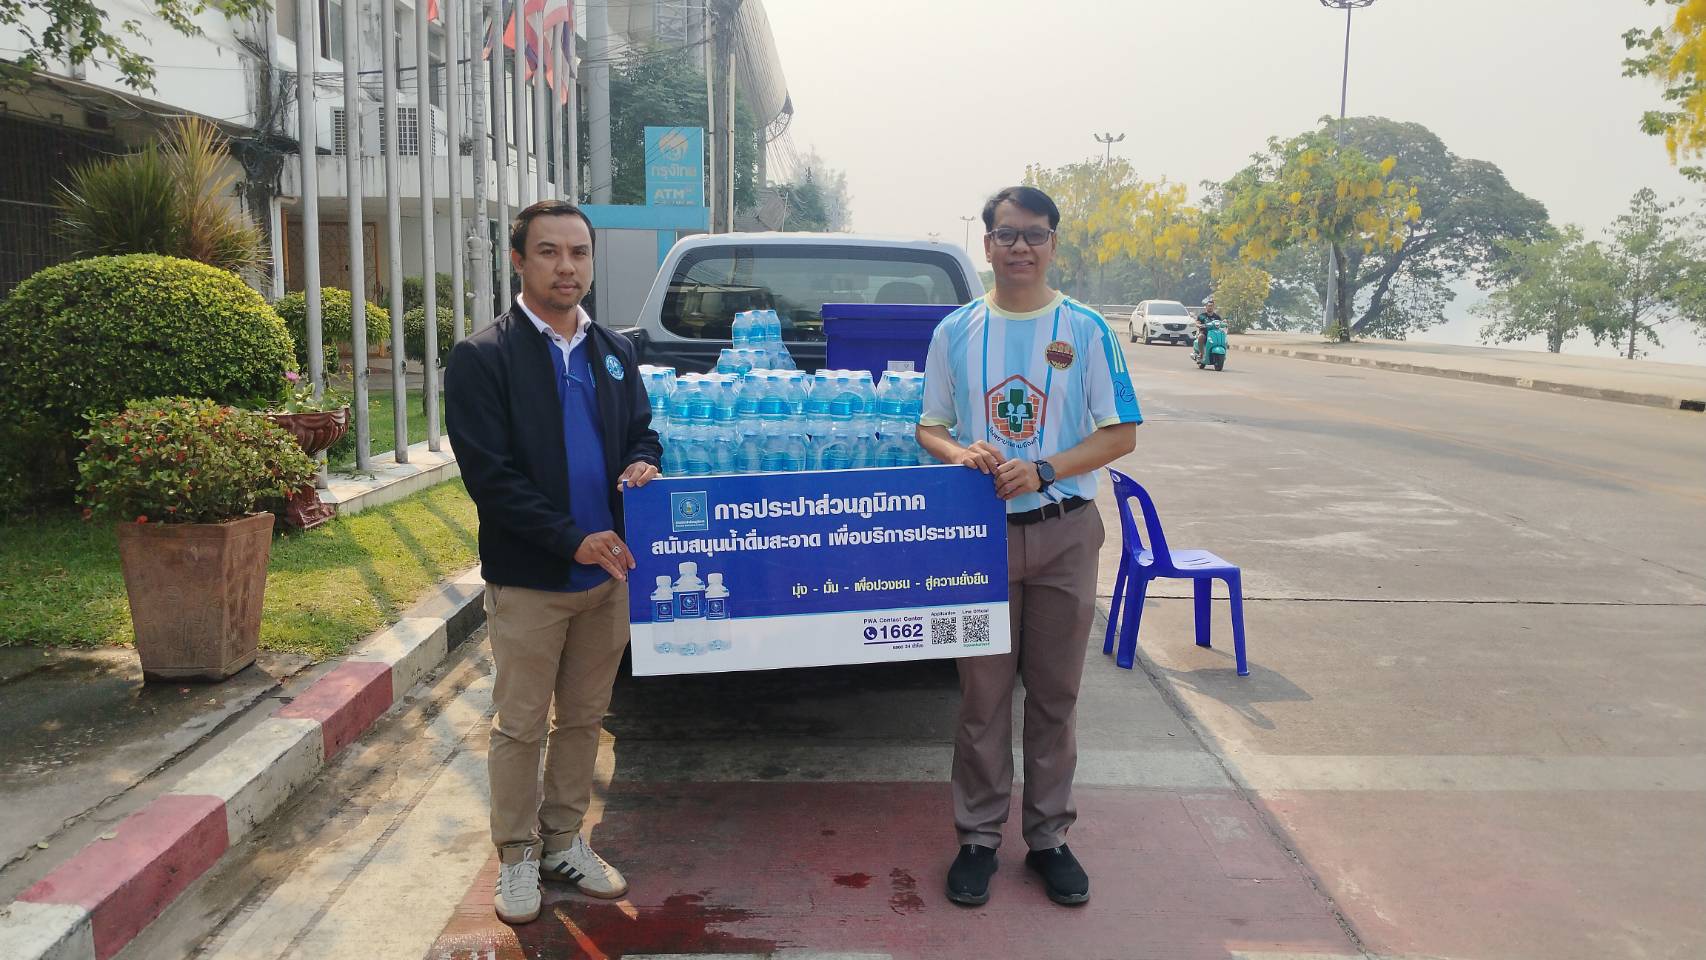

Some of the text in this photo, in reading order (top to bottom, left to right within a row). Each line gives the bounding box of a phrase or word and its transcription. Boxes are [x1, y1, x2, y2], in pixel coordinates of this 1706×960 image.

[654, 189, 685, 199] ATM
[714, 490, 926, 521] การประปาส่วนภูมิภาค
[651, 523, 988, 557] สนับสนุนน้ำดื่มสะอาด เพื่อบริการประชาชน
[792, 582, 808, 598] มุ่ง
[823, 579, 839, 594] มั่น
[854, 577, 911, 592] เพื่อปวงชน
[925, 571, 989, 591] สู่ความยั่งยืน
[880, 623, 924, 639] 1662
